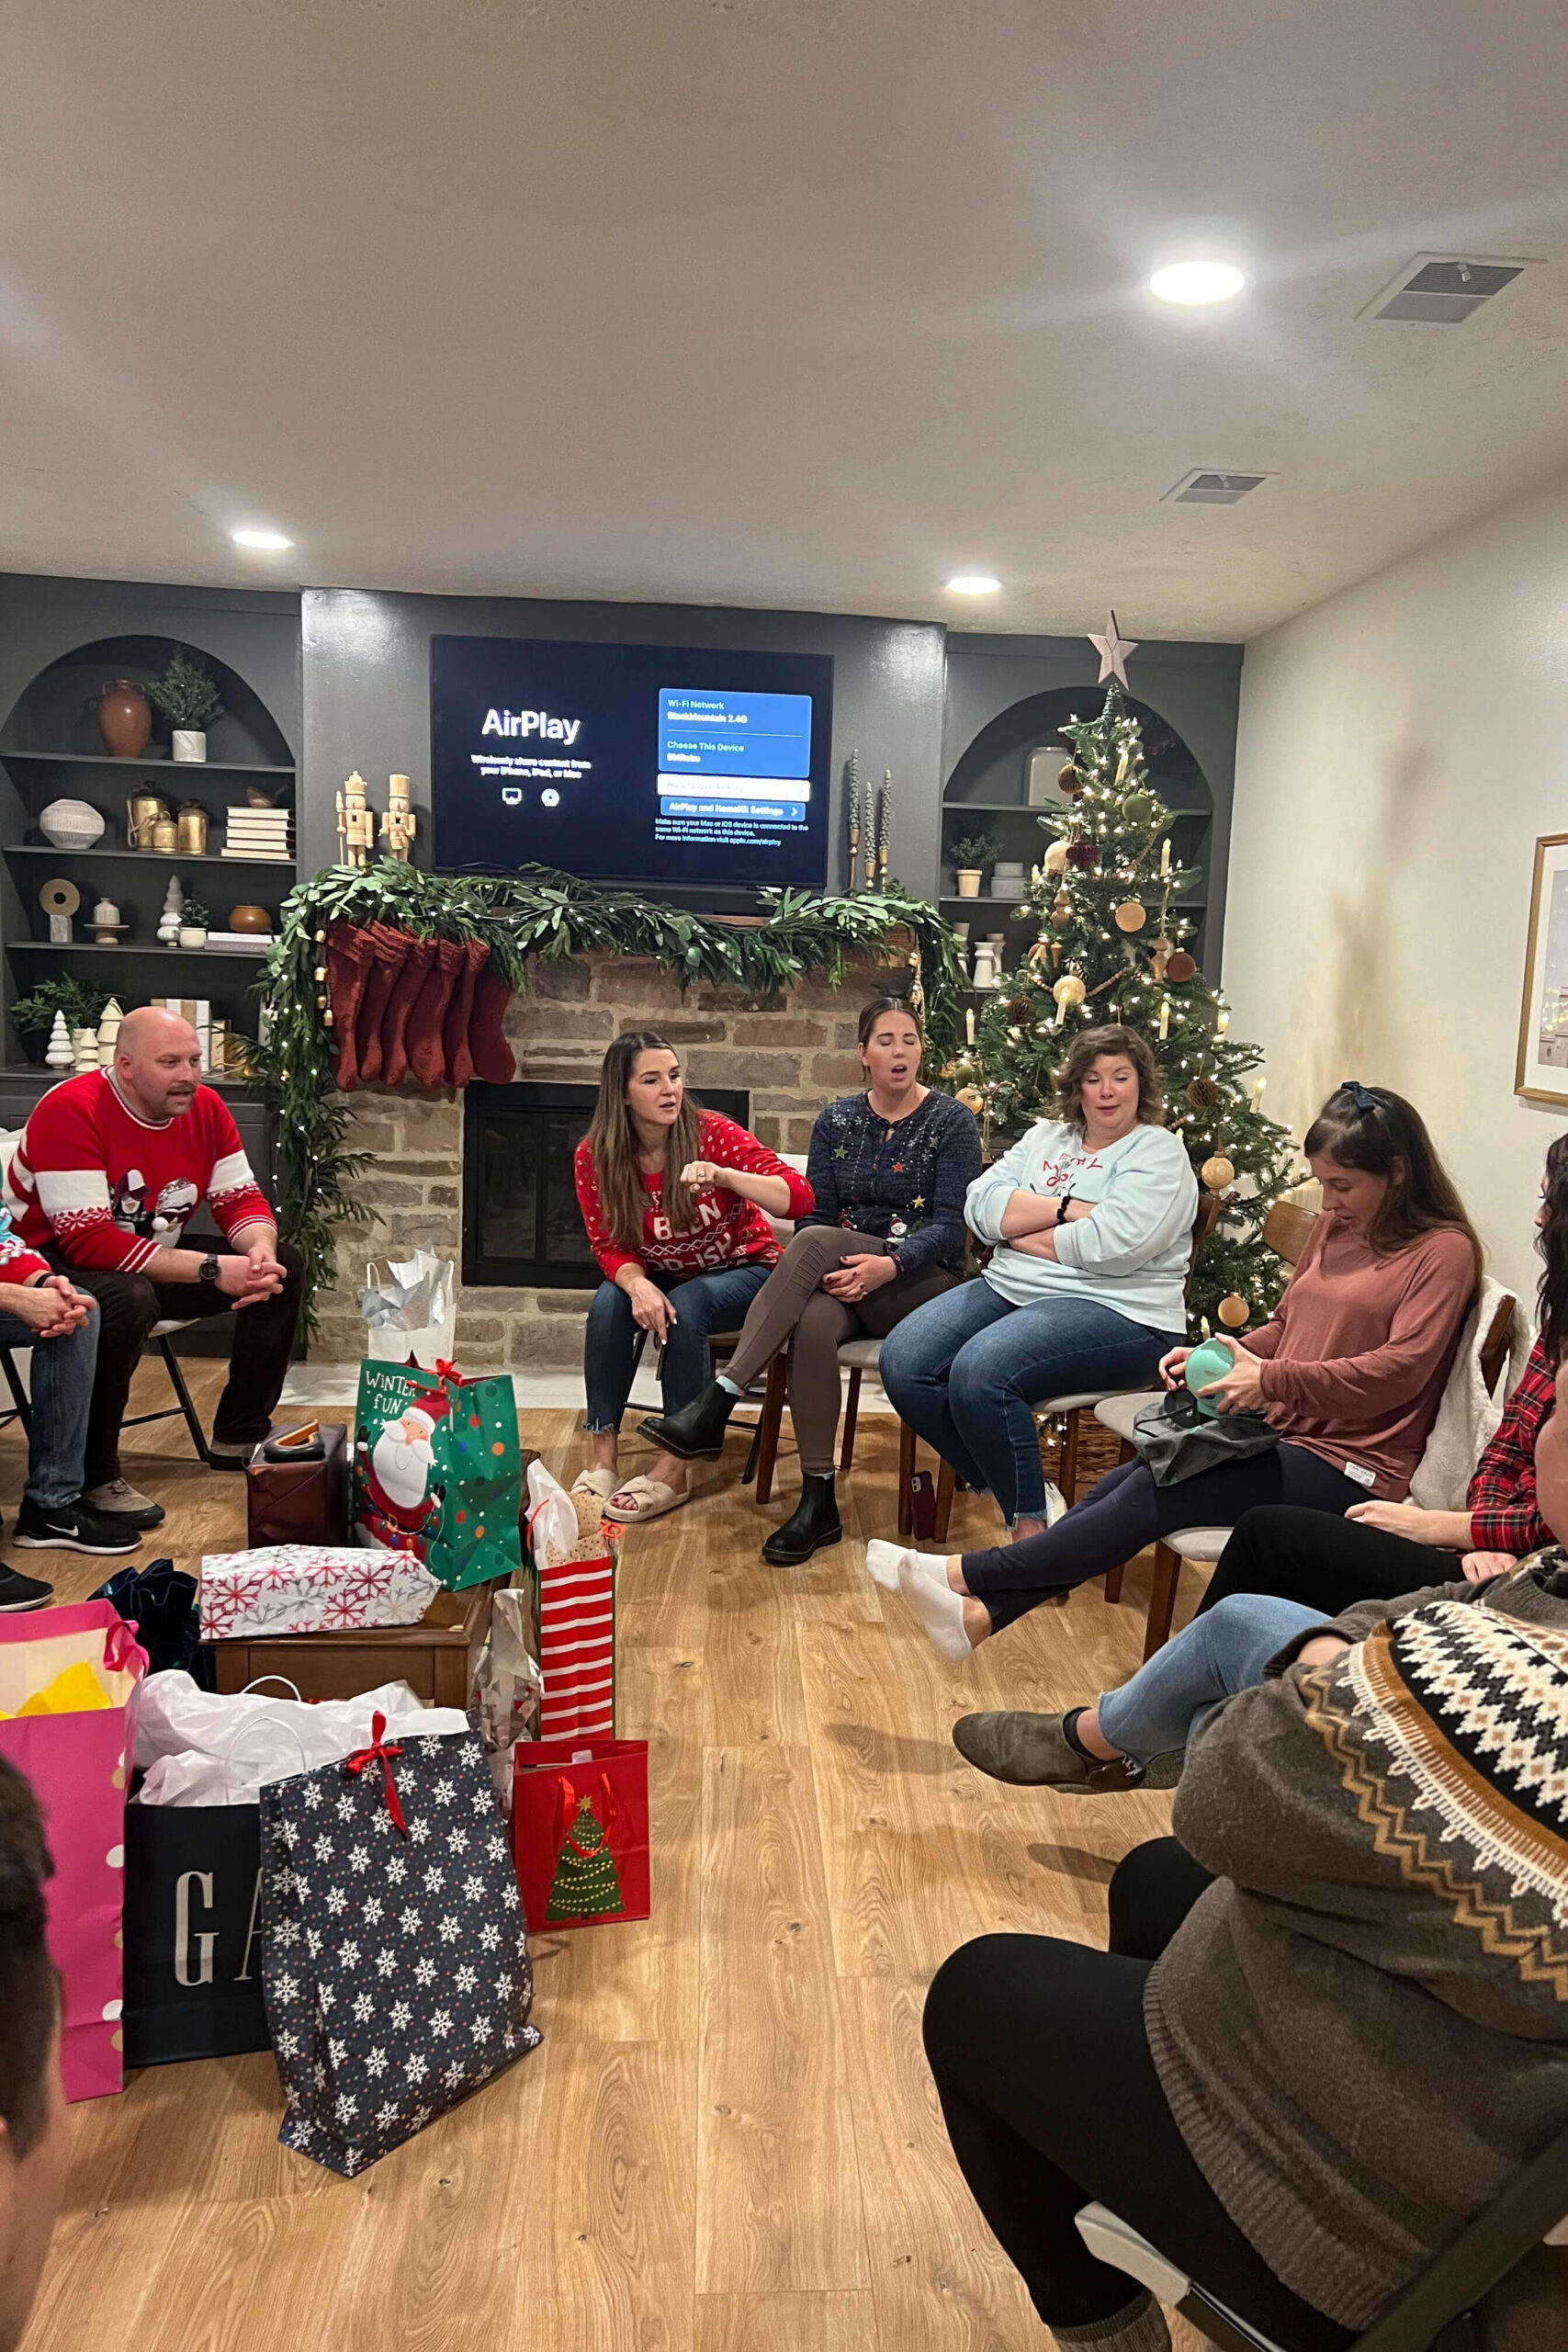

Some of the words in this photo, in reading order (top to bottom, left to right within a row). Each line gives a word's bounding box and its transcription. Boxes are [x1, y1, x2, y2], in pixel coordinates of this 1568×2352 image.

[691, 701, 725, 710] Network
[481, 708, 581, 745] AirPlay
[667, 741, 697, 750] Choose
[699, 742, 716, 752] This
[717, 743, 744, 752] Device
[669, 802, 698, 813] AirPlay
[698, 804, 715, 812] and
[715, 804, 750, 813] HomeKit
[750, 806, 784, 817] Settings
